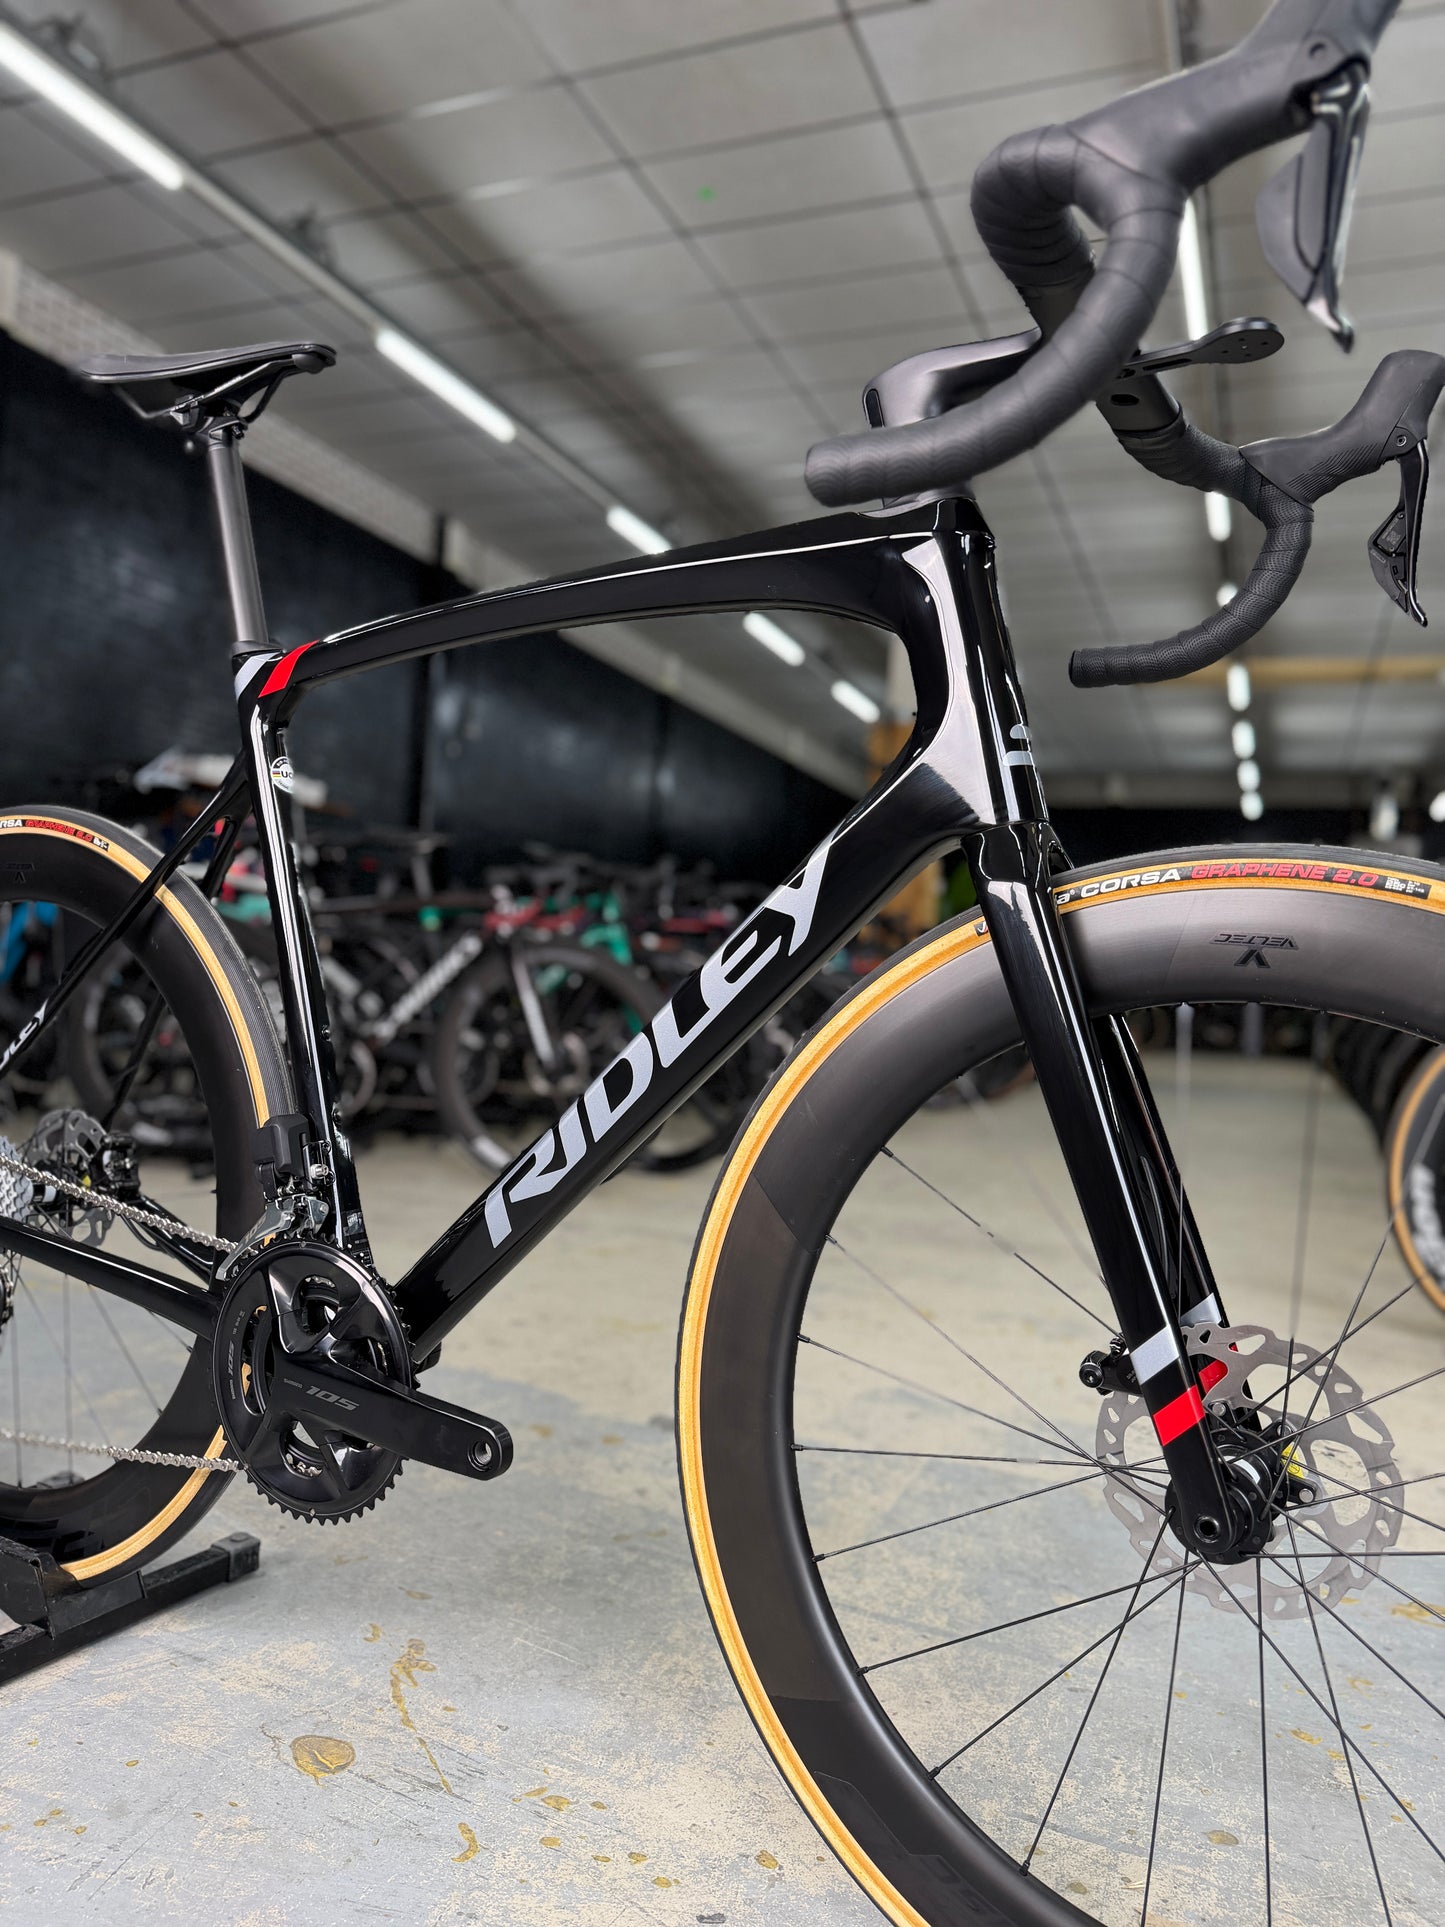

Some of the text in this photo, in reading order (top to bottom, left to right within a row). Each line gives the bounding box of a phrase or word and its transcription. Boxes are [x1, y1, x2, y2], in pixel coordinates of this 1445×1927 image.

[1080, 868, 1181, 898] CORSA
[1191, 863, 1329, 879] GRAPHENE
[1332, 868, 1379, 887] 2.0
[484, 818, 846, 1249] RIDLEY
[305, 1385, 360, 1411] 105
